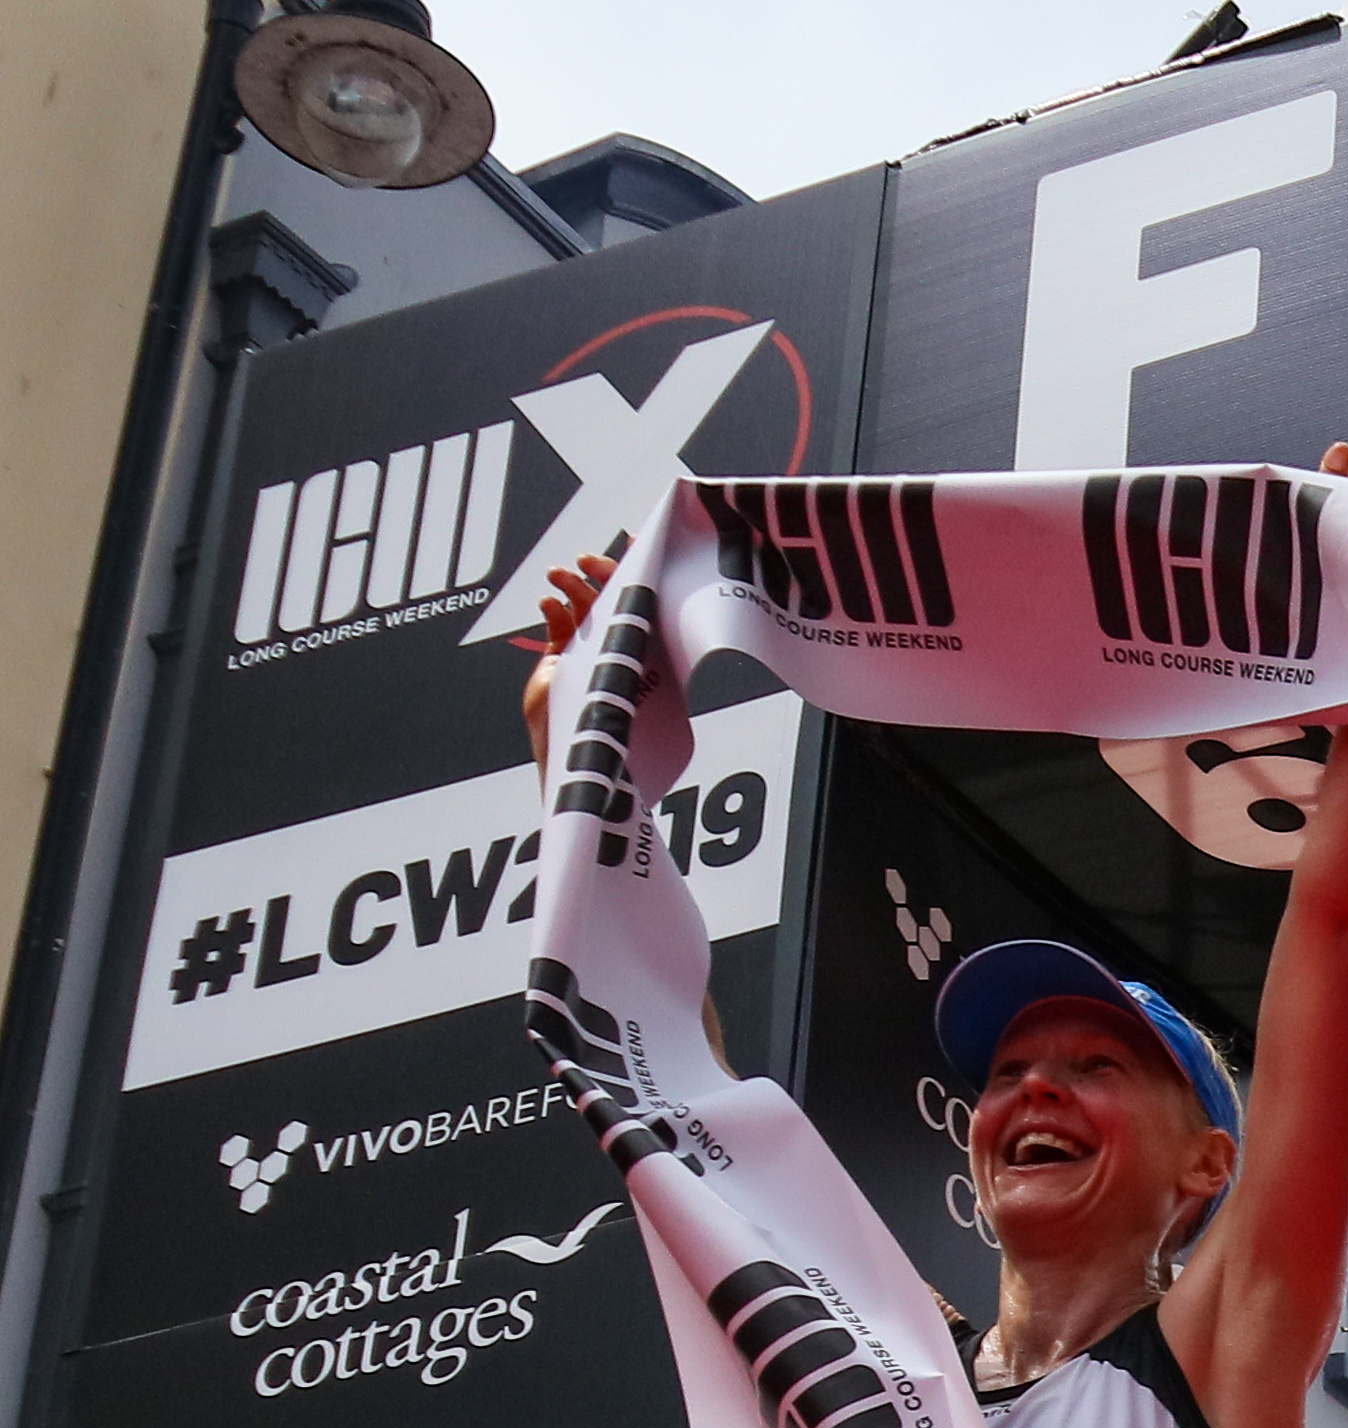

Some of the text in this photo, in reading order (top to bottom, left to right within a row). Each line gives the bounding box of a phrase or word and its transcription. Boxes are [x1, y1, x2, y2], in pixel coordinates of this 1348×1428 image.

[227, 586, 491, 671] LONG COURSE WEEKEND
[717, 585, 964, 653] LONG COURSE WEEKEND
[1102, 646, 1316, 687] LONG COURSE WEEKEND
[170, 771, 768, 1004] #LCW19
[313, 1081, 579, 1173] VIVOBAREF
[687, 1119, 734, 1172] LONG
[230, 1208, 470, 1337] coastal
[804, 1267, 872, 1339] WEEKEND
[254, 1288, 538, 1398] cottages
[873, 1340, 921, 1412] COURSE
